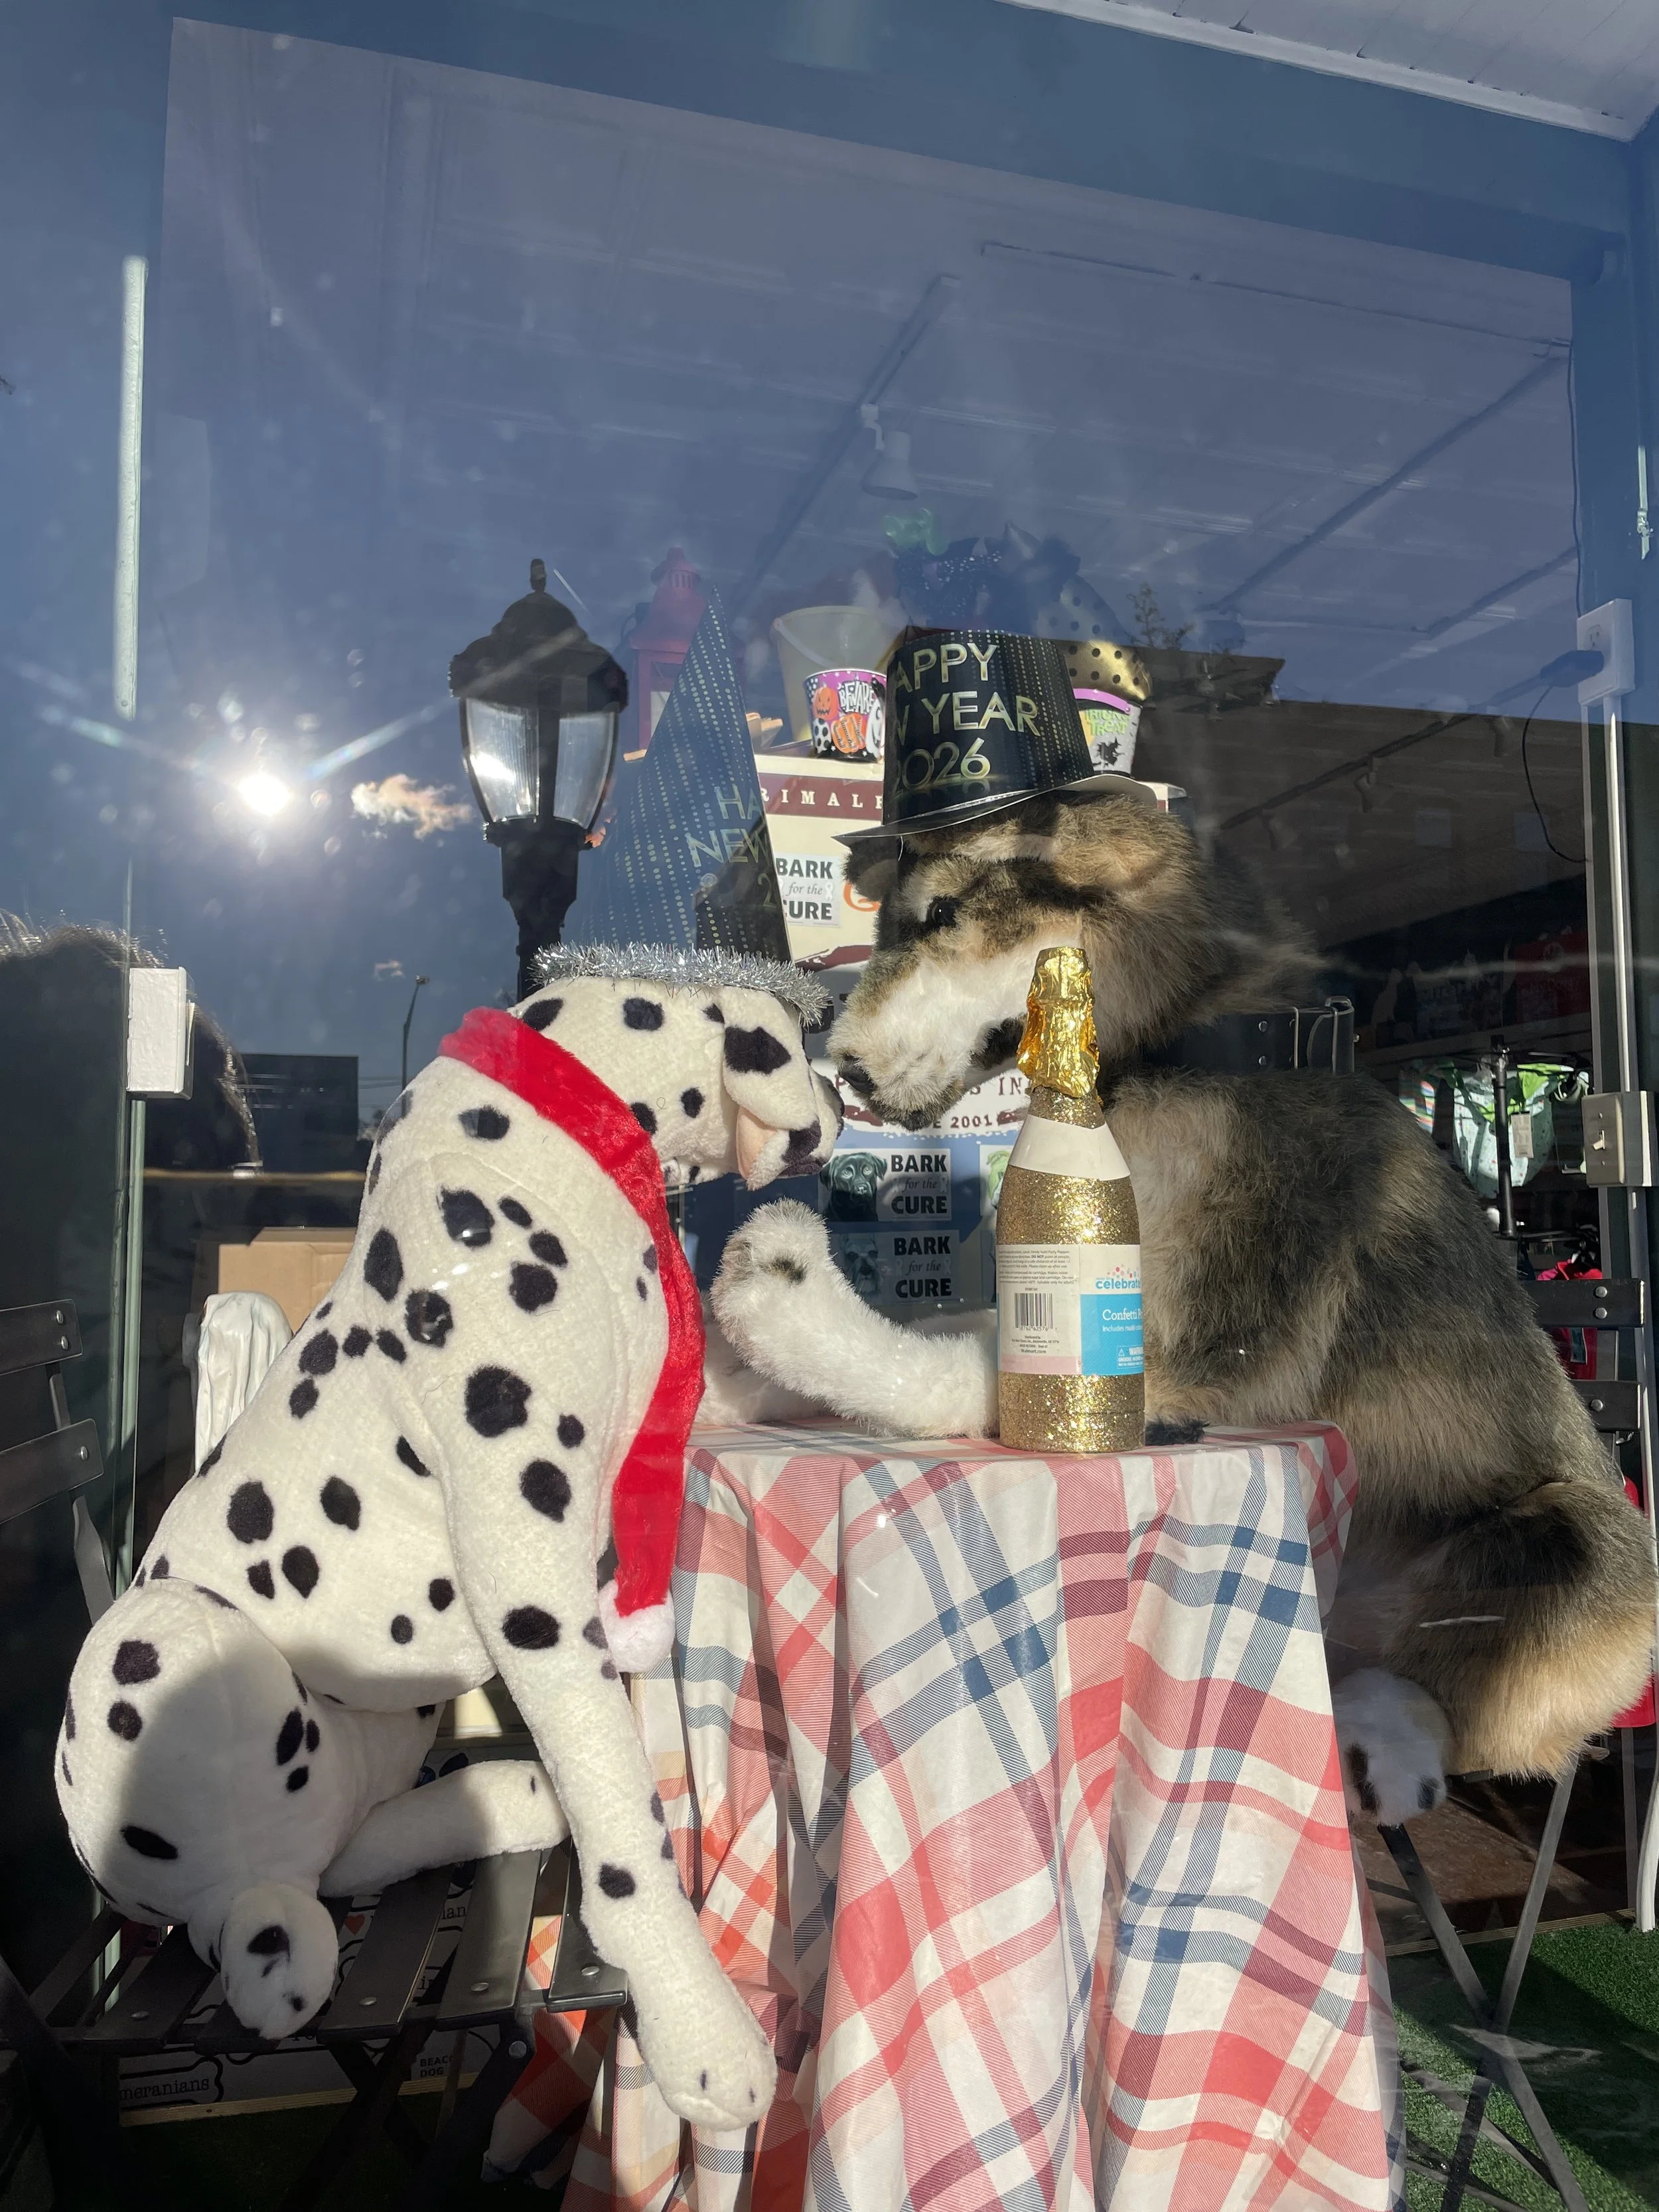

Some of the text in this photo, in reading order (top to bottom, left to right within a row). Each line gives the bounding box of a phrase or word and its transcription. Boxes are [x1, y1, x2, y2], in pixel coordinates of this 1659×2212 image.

[839, 681, 875, 714] BEWARE
[921, 691, 1041, 737] YEAR
[685, 828, 771, 867] NEW
[776, 857, 833, 879] BARK
[786, 882, 823, 896] for the
[783, 899, 832, 921] URE
[950, 1114, 993, 1129] 2001
[891, 1155, 947, 1172] BARK
[902, 1177, 937, 1192] for the
[891, 1196, 948, 1214] CURE
[894, 1236, 950, 1256] BARK
[905, 1260, 941, 1276] for the
[895, 1278, 952, 1298] CURE
[1096, 1278, 1141, 1289] celebrate
[1102, 1308, 1137, 1321] Confetti
[420, 2067, 444, 2077] DOG
[119, 2078, 209, 2101] meranians
